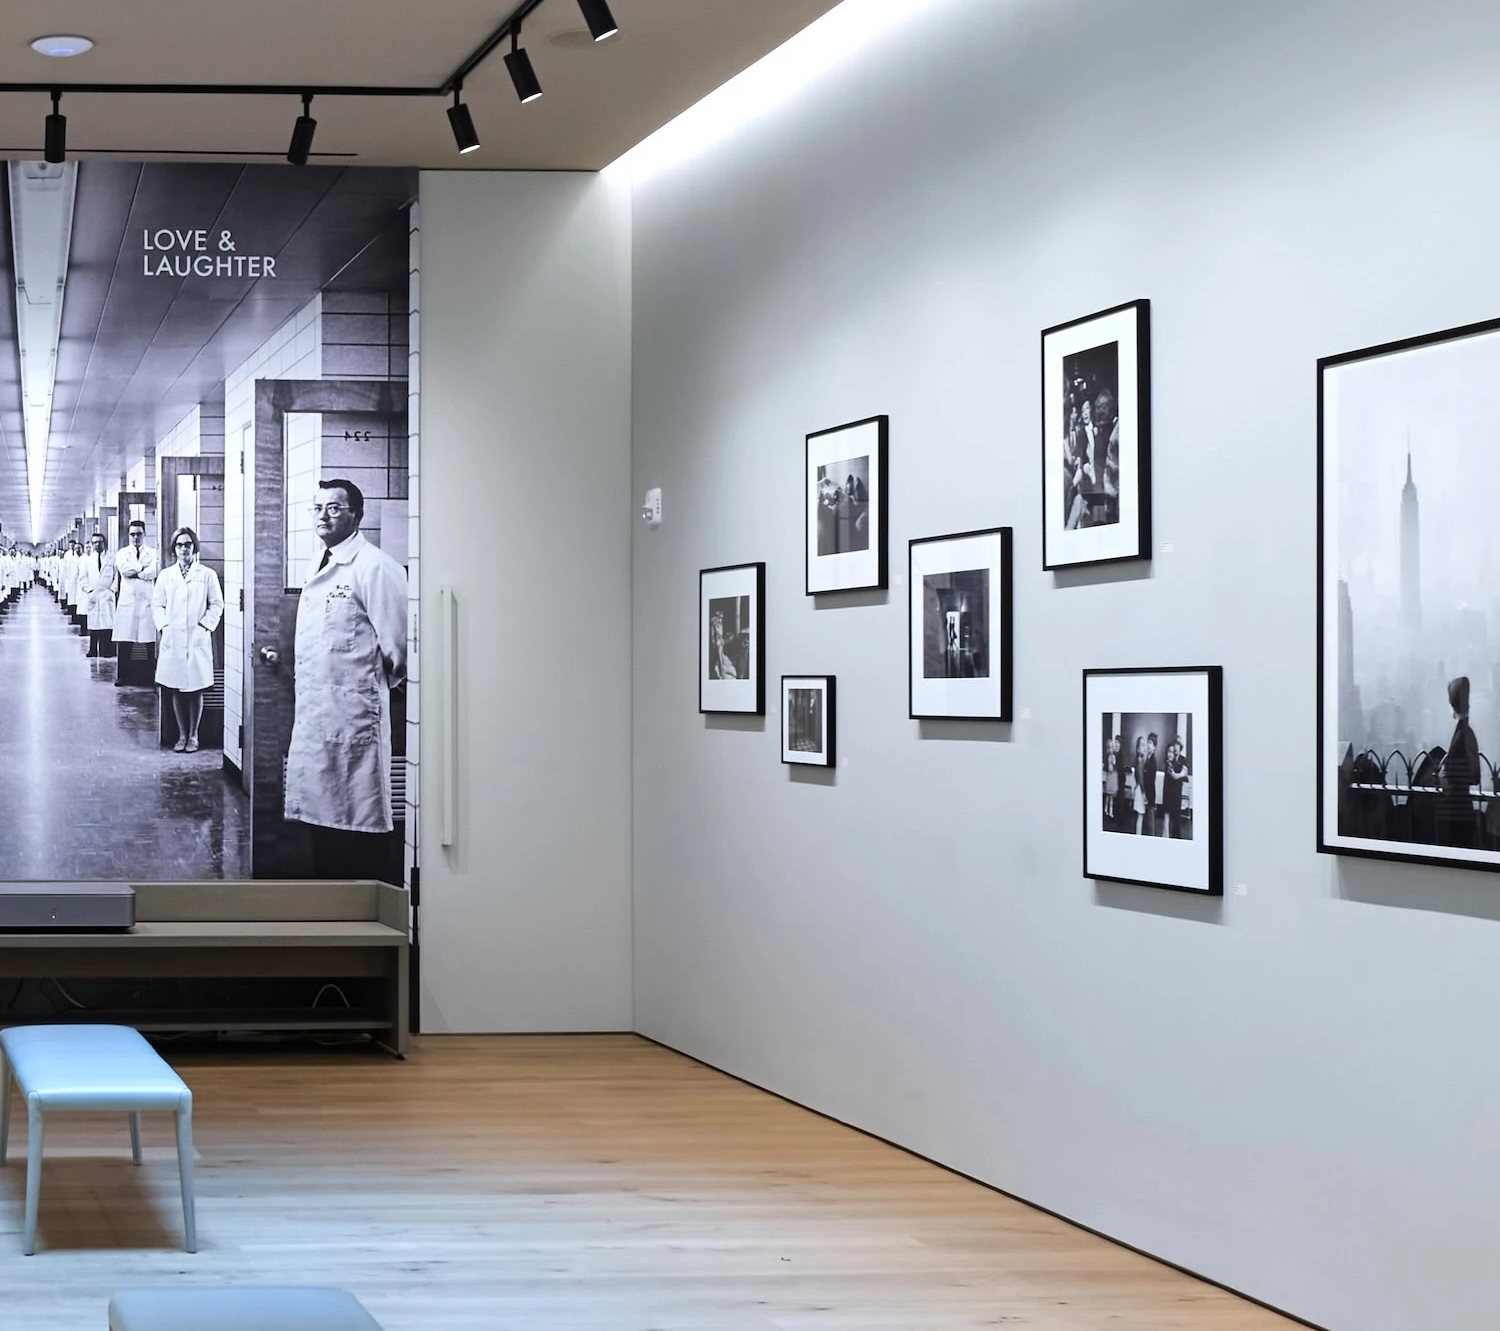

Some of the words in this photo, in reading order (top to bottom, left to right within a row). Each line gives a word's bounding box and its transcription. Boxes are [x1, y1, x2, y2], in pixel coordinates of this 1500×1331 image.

[143, 229, 207, 251] LOVE
[218, 230, 236, 251] &
[143, 254, 277, 277] LAUGHTER
